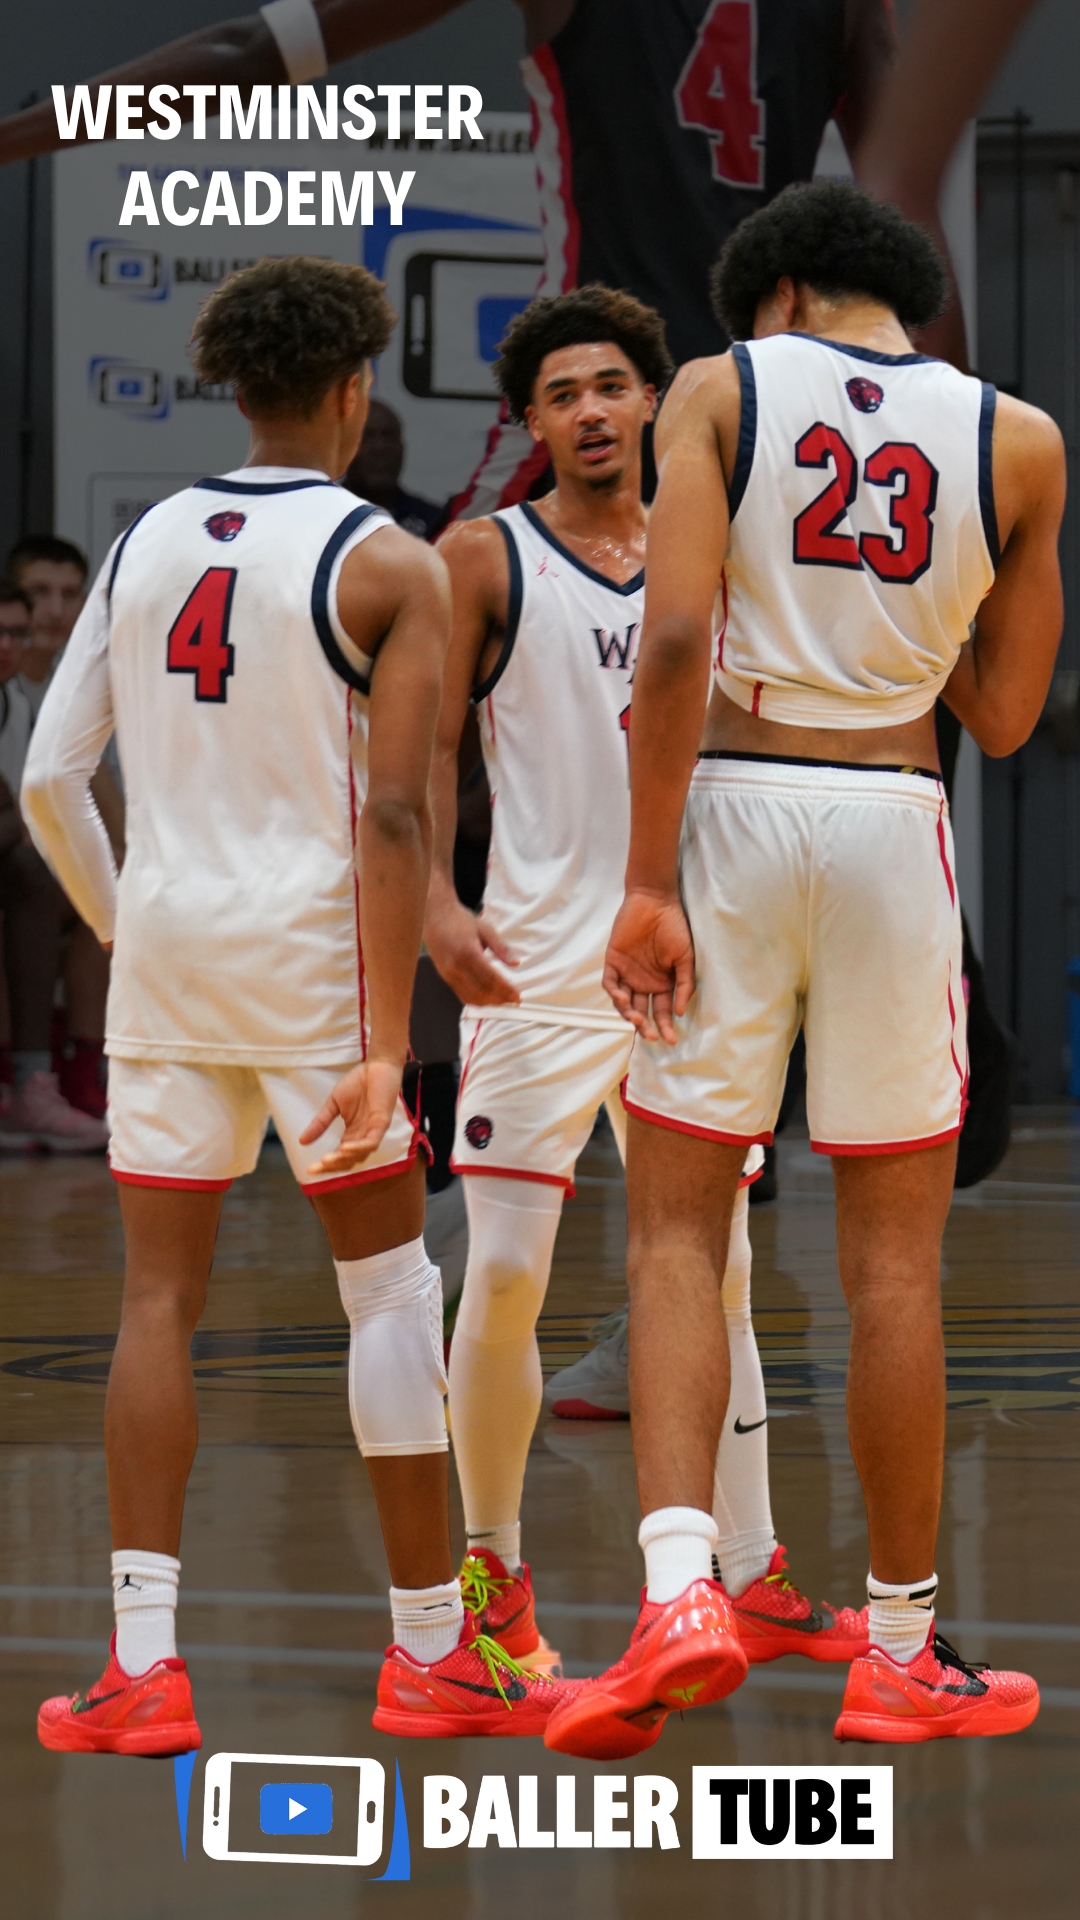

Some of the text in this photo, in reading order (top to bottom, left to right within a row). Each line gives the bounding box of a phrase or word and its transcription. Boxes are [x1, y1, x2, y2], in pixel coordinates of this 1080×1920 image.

[673, 0, 766, 190] 4
[793, 421, 938, 585] 23
[166, 566, 238, 704] 4
[589, 622, 645, 685] W
